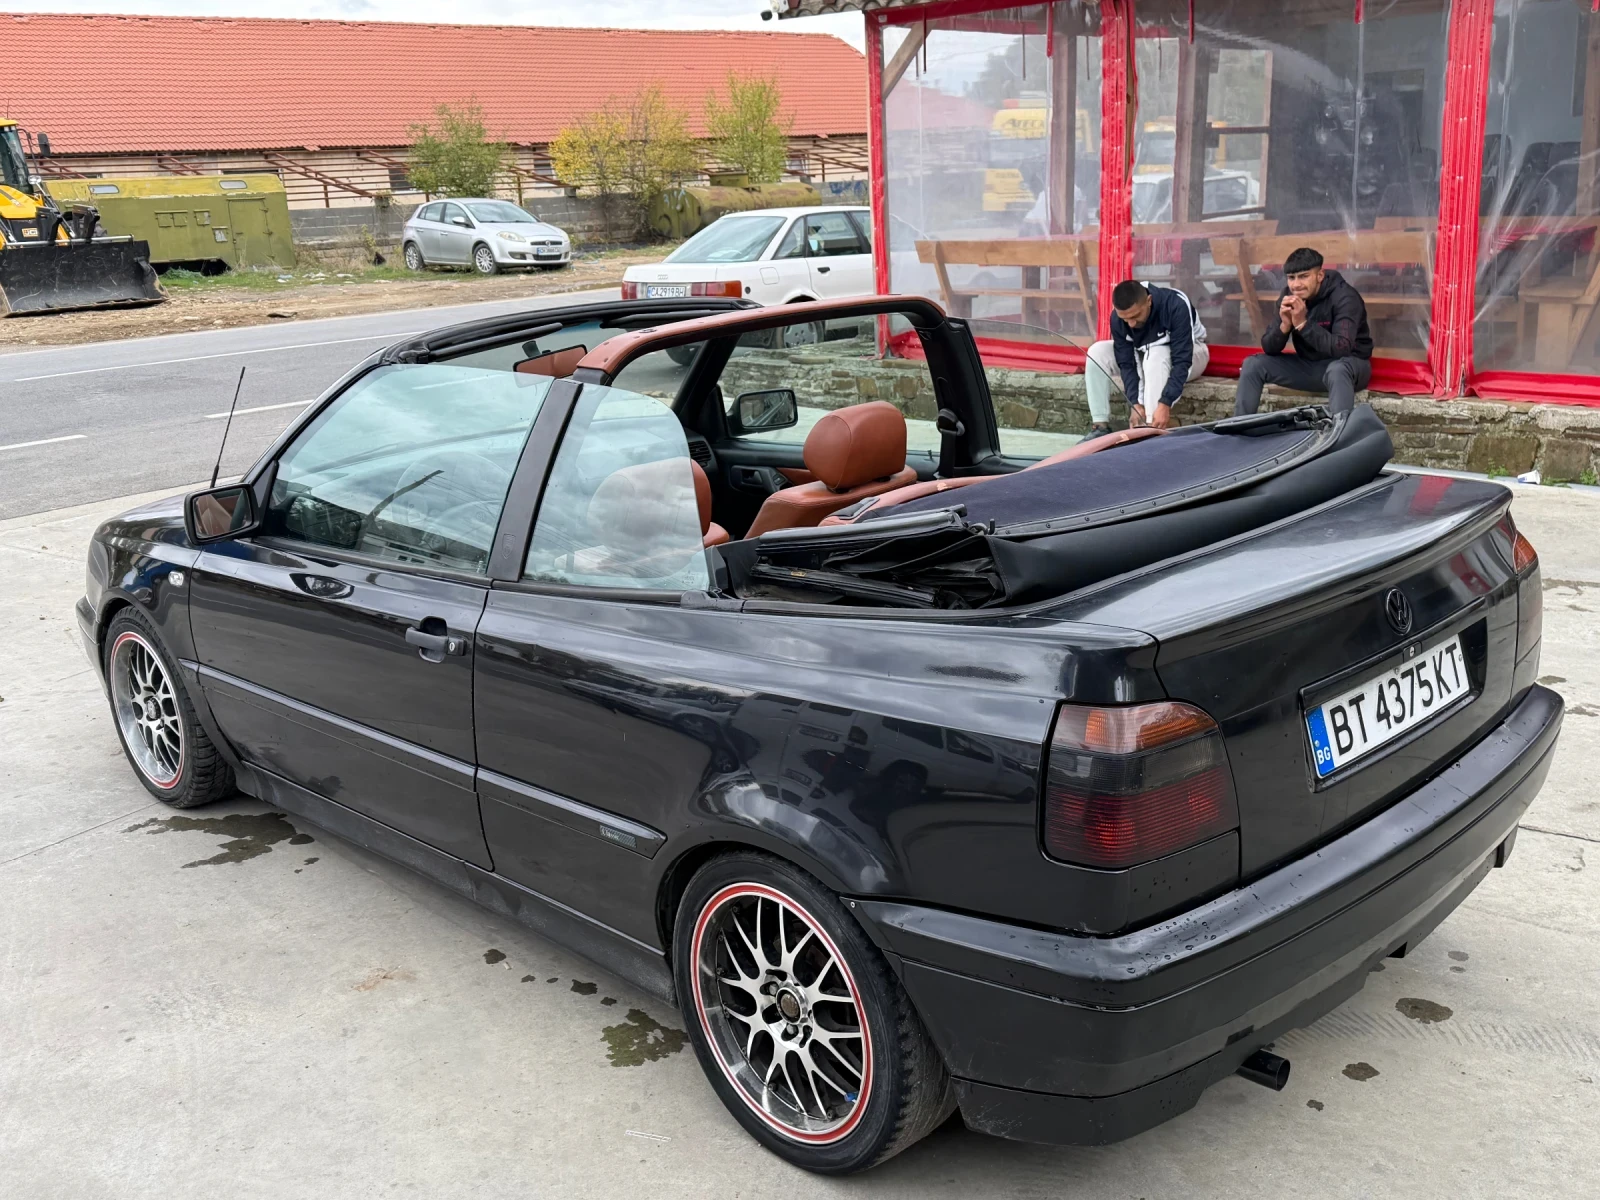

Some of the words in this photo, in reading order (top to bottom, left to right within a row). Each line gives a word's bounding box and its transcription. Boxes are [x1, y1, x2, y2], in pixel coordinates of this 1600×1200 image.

[1329, 693, 1368, 757] BT
[1376, 660, 1434, 730] 4375
[1432, 642, 1461, 700] KT
[1316, 746, 1331, 765] BG
